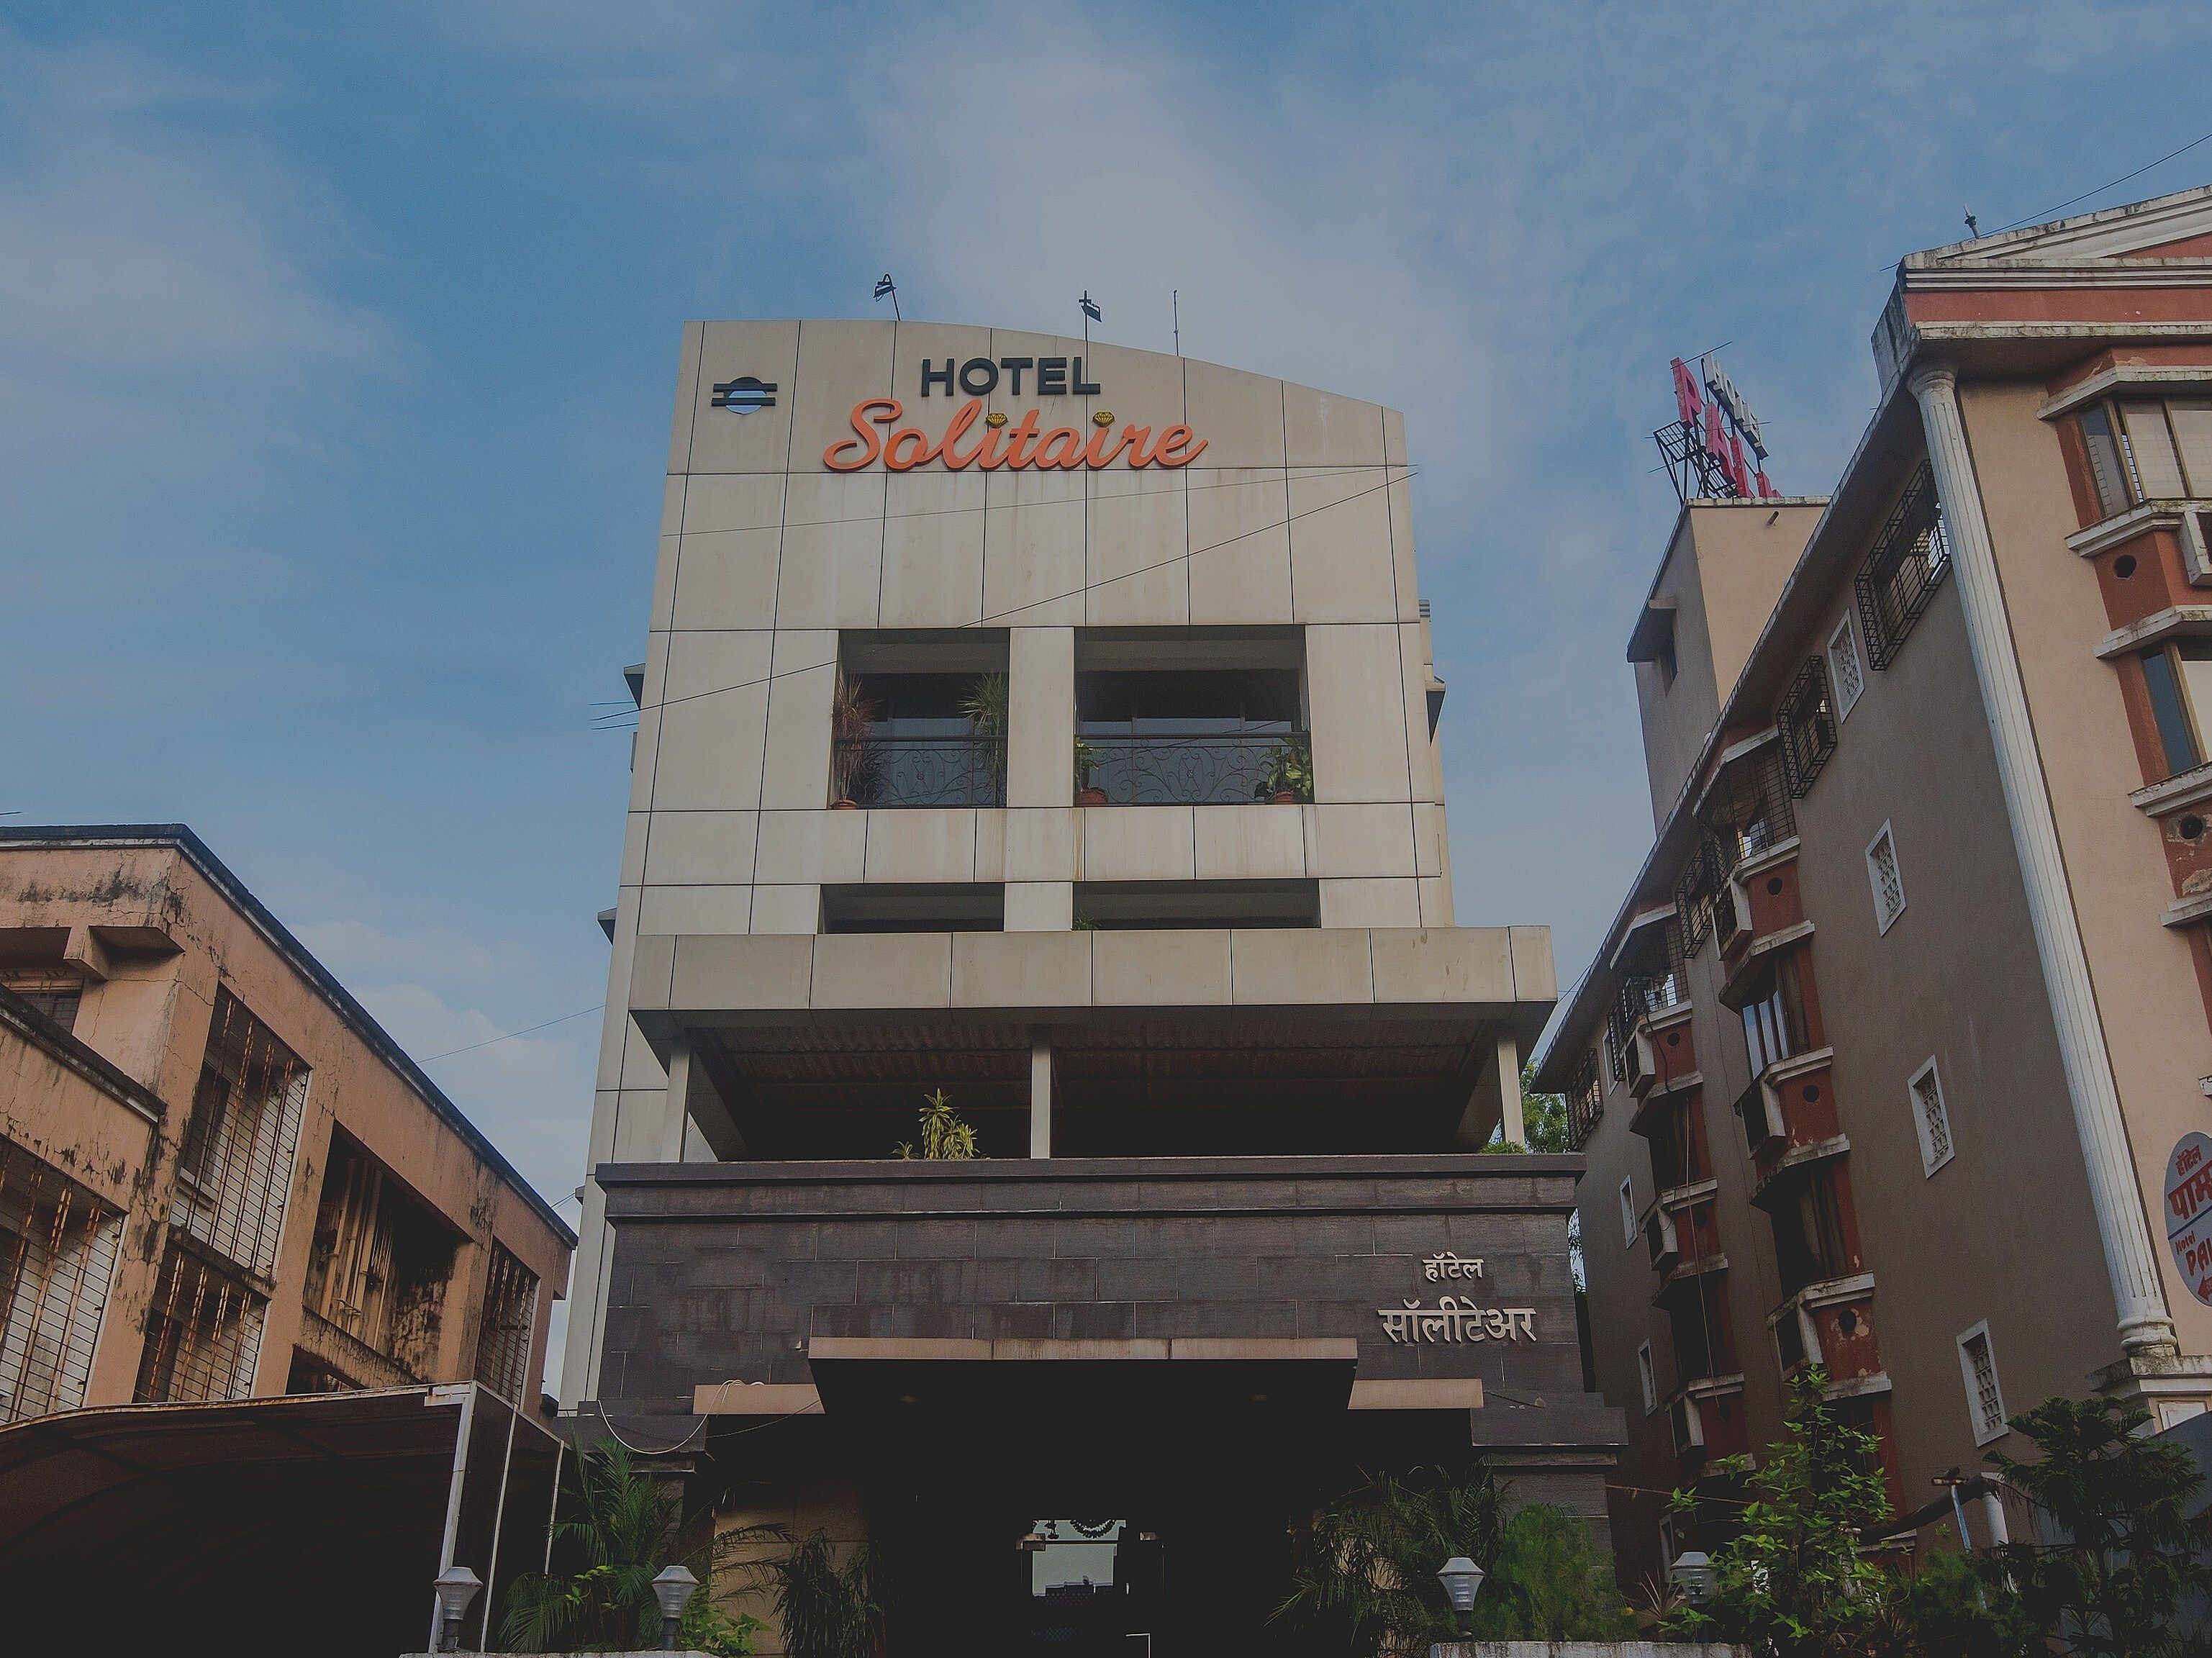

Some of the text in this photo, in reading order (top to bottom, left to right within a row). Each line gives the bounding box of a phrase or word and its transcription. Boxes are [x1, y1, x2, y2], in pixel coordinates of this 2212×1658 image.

[921, 356, 1100, 397] HOTEL
[823, 398, 1208, 471] Solitaire
[1423, 1251, 1484, 1282] हॉटेल
[1377, 1295, 1537, 1343] सॉलीटेअर
